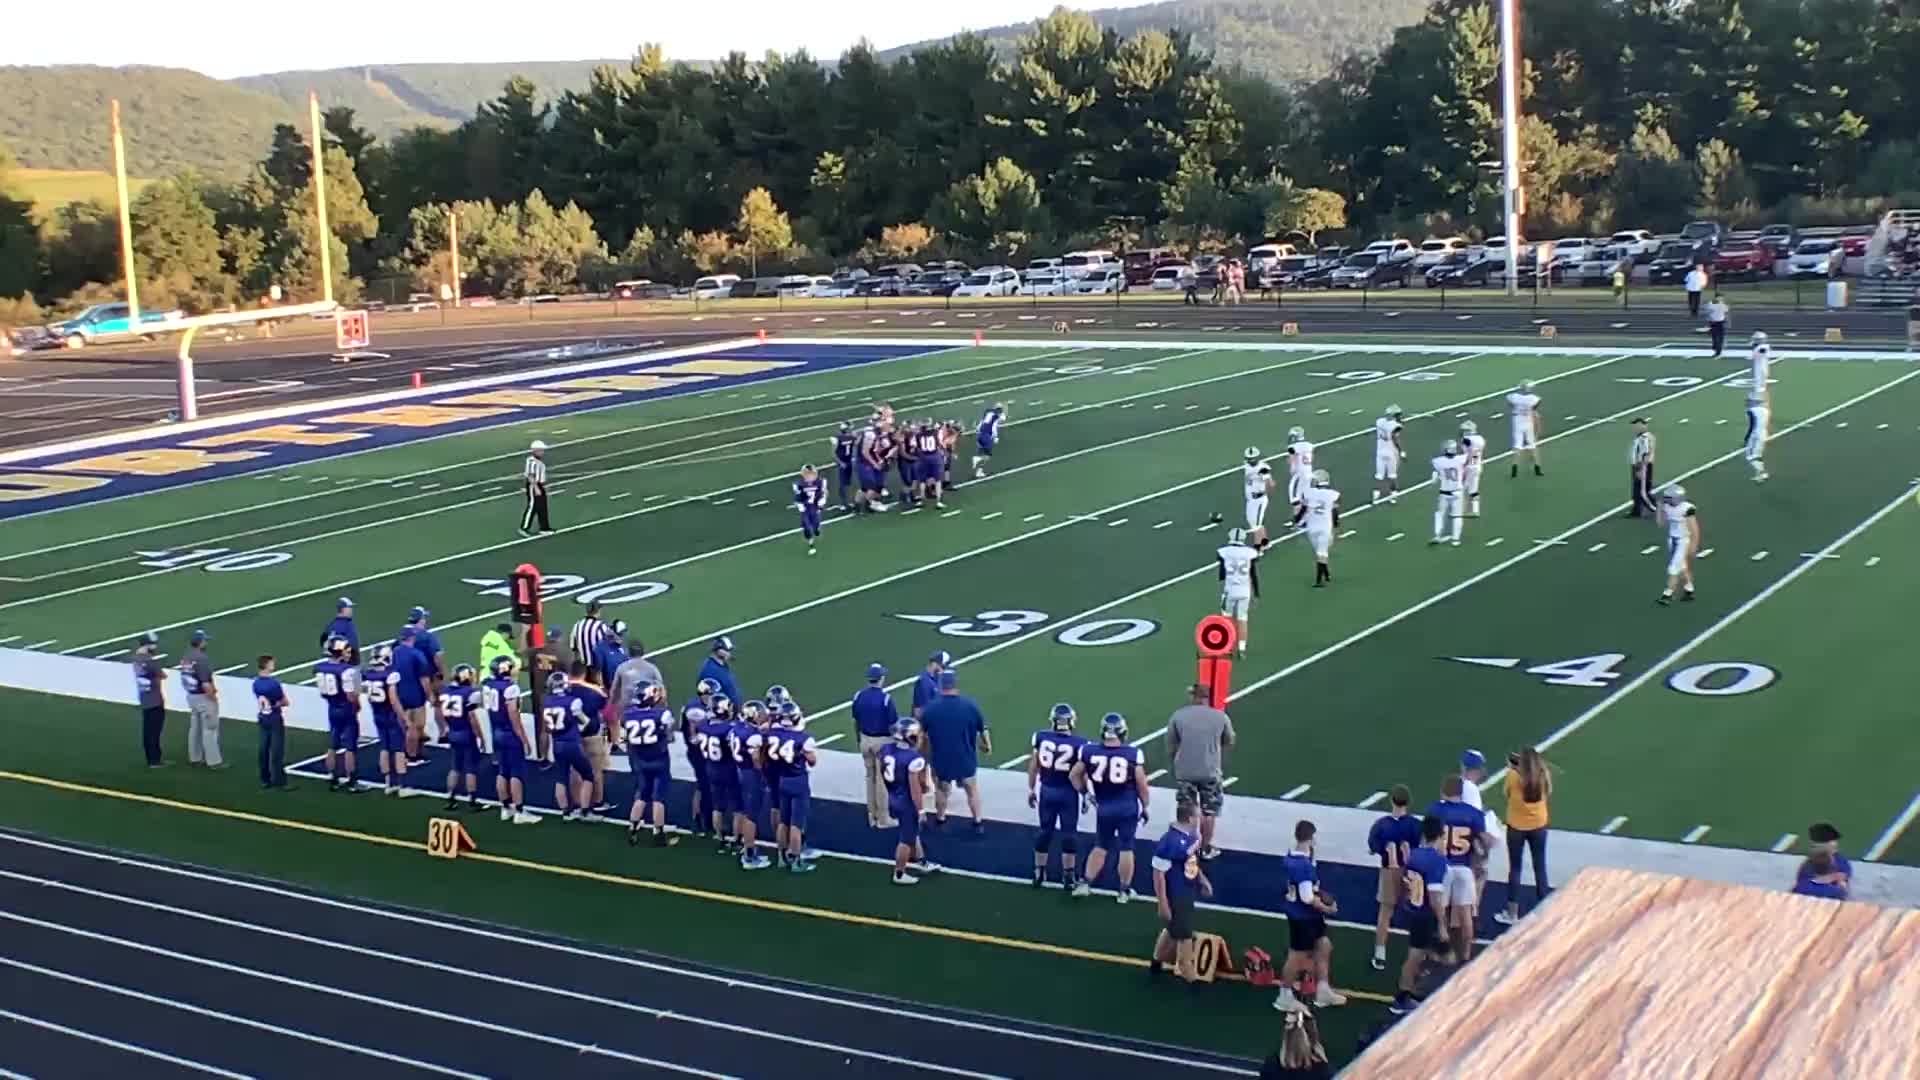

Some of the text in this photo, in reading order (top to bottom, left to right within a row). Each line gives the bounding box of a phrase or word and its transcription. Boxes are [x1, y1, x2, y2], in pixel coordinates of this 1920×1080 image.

[939, 609, 1156, 646] 30
[1525, 653, 1777, 697] 40
[625, 719, 658, 745] 22
[767, 735, 795, 764] 24
[1039, 740, 1074, 771] 62
[431, 822, 453, 854] 30
